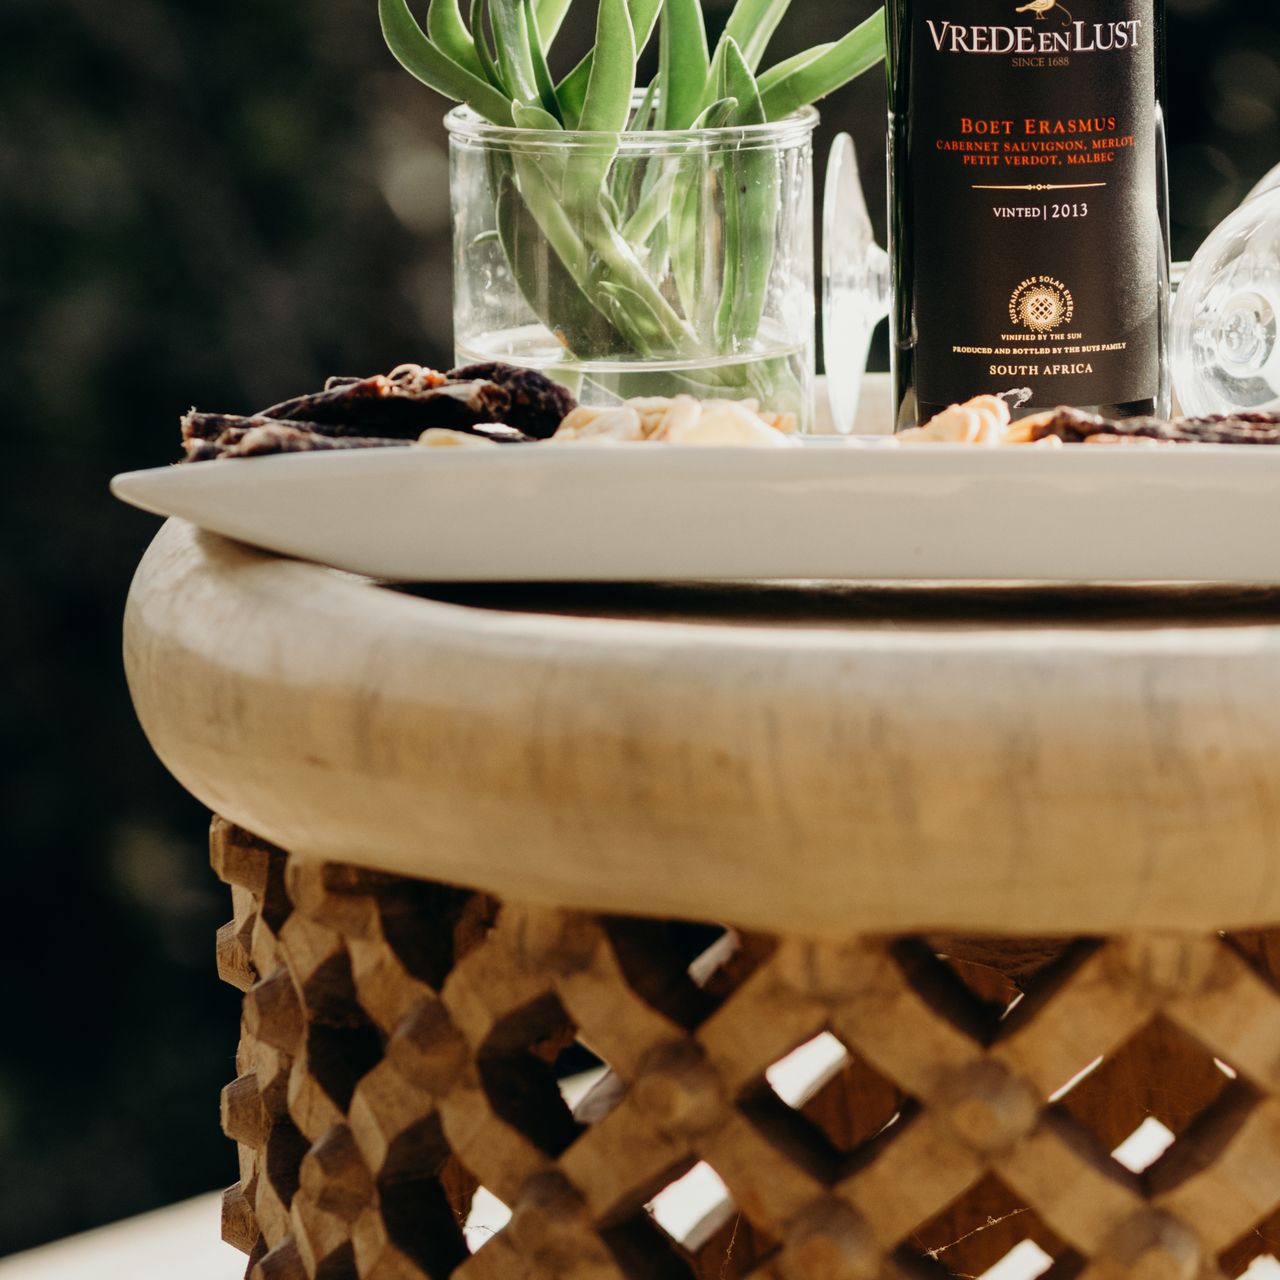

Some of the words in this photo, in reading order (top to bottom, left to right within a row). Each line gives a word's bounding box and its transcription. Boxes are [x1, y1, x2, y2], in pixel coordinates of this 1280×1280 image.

[1072, 20, 1141, 52] LUST
[1012, 57, 1045, 67] SINCE
[1048, 56, 1069, 67] 1688
[961, 118, 1014, 134] BOET
[1025, 117, 1116, 134] ERASMUS
[936, 140, 1000, 152] CABERNET
[1004, 140, 1087, 152] SAUVIGNON,
[963, 155, 1000, 166] PETIT
[1004, 155, 1062, 166] VERDOT,
[1067, 152, 1115, 165] MALBEC
[993, 207, 1041, 218] VINTED
[1051, 203, 1089, 219] 2013
[1009, 276, 1037, 324] SUSTAINABLE
[1039, 275, 1065, 291] SOLAR
[1062, 289, 1074, 324] ENERGY
[1001, 333, 1036, 341] VINIFIED
[1050, 333, 1065, 341] THE
[1067, 332, 1082, 340] SUN
[952, 346, 993, 354] PRODUCED
[1012, 347, 1050, 355] BOTTLED
[1064, 346, 1080, 354] THE
[1101, 342, 1127, 351] FAMILY
[989, 365, 1039, 376] SOUTH
[1043, 363, 1093, 375] AFRICA
